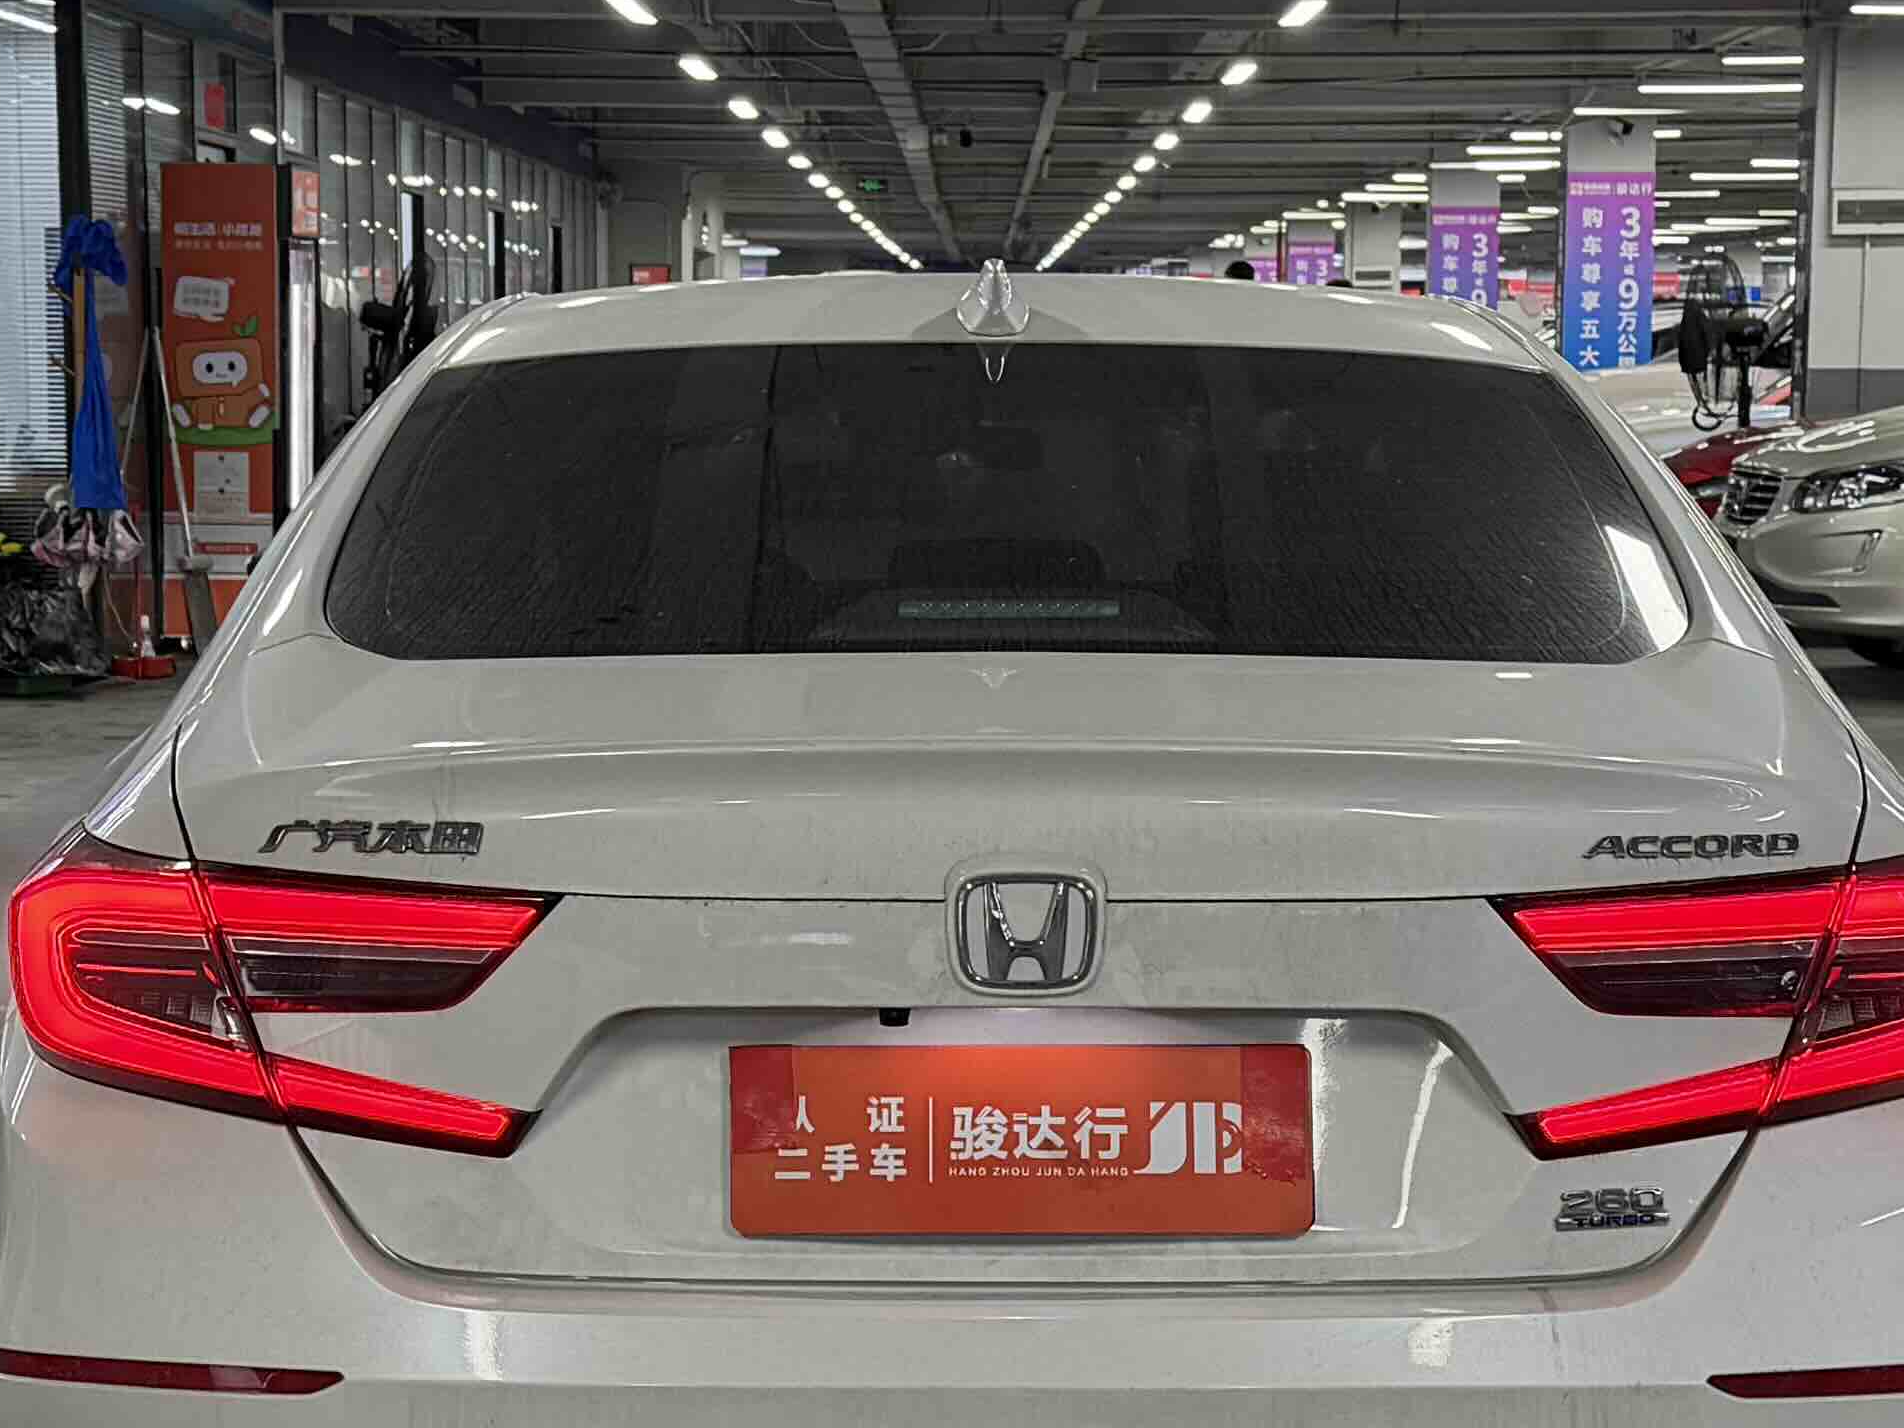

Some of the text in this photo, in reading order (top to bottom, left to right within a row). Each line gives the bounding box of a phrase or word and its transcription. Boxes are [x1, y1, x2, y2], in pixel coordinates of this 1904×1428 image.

[257, 819, 484, 854] 广汽本田
[1580, 833, 1800, 860] ACCORD
[949, 1105, 1130, 1160] 骏达行
[774, 1142, 908, 1183] 二手车
[948, 1166, 1129, 1178] HANG ZHOU JUN DA HANG
[1559, 1187, 1665, 1213] 260
